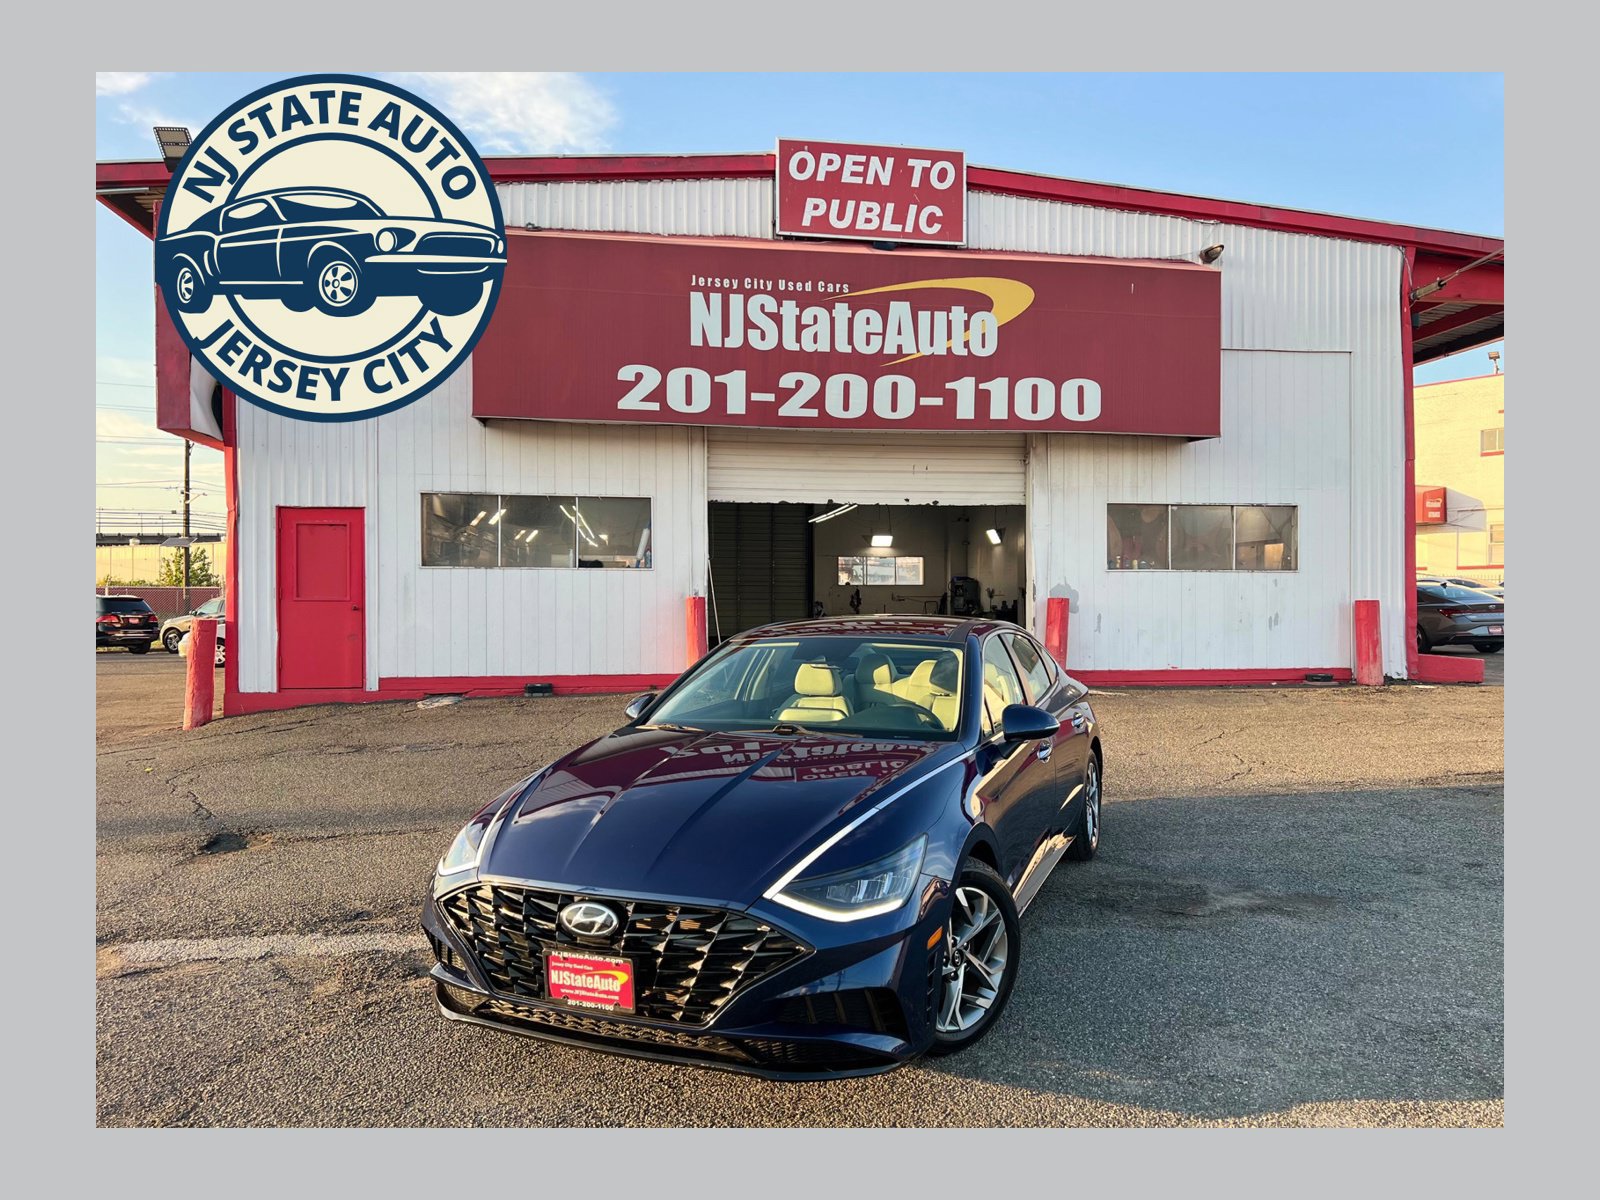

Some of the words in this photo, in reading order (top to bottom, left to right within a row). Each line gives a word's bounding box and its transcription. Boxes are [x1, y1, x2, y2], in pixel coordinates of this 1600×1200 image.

[788, 149, 894, 187] OPEN
[907, 158, 956, 190] TO
[801, 197, 943, 235] PUBLIC
[691, 274, 738, 289] Jersey
[744, 277, 773, 291] City
[778, 279, 812, 292] Used
[818, 280, 849, 293] Cars
[690, 291, 998, 357] NJStateAuto
[616, 364, 1102, 422] 201-200-1100
[551, 969, 621, 992] NJStateAuto
[567, 999, 614, 1011] 201-200-1100
